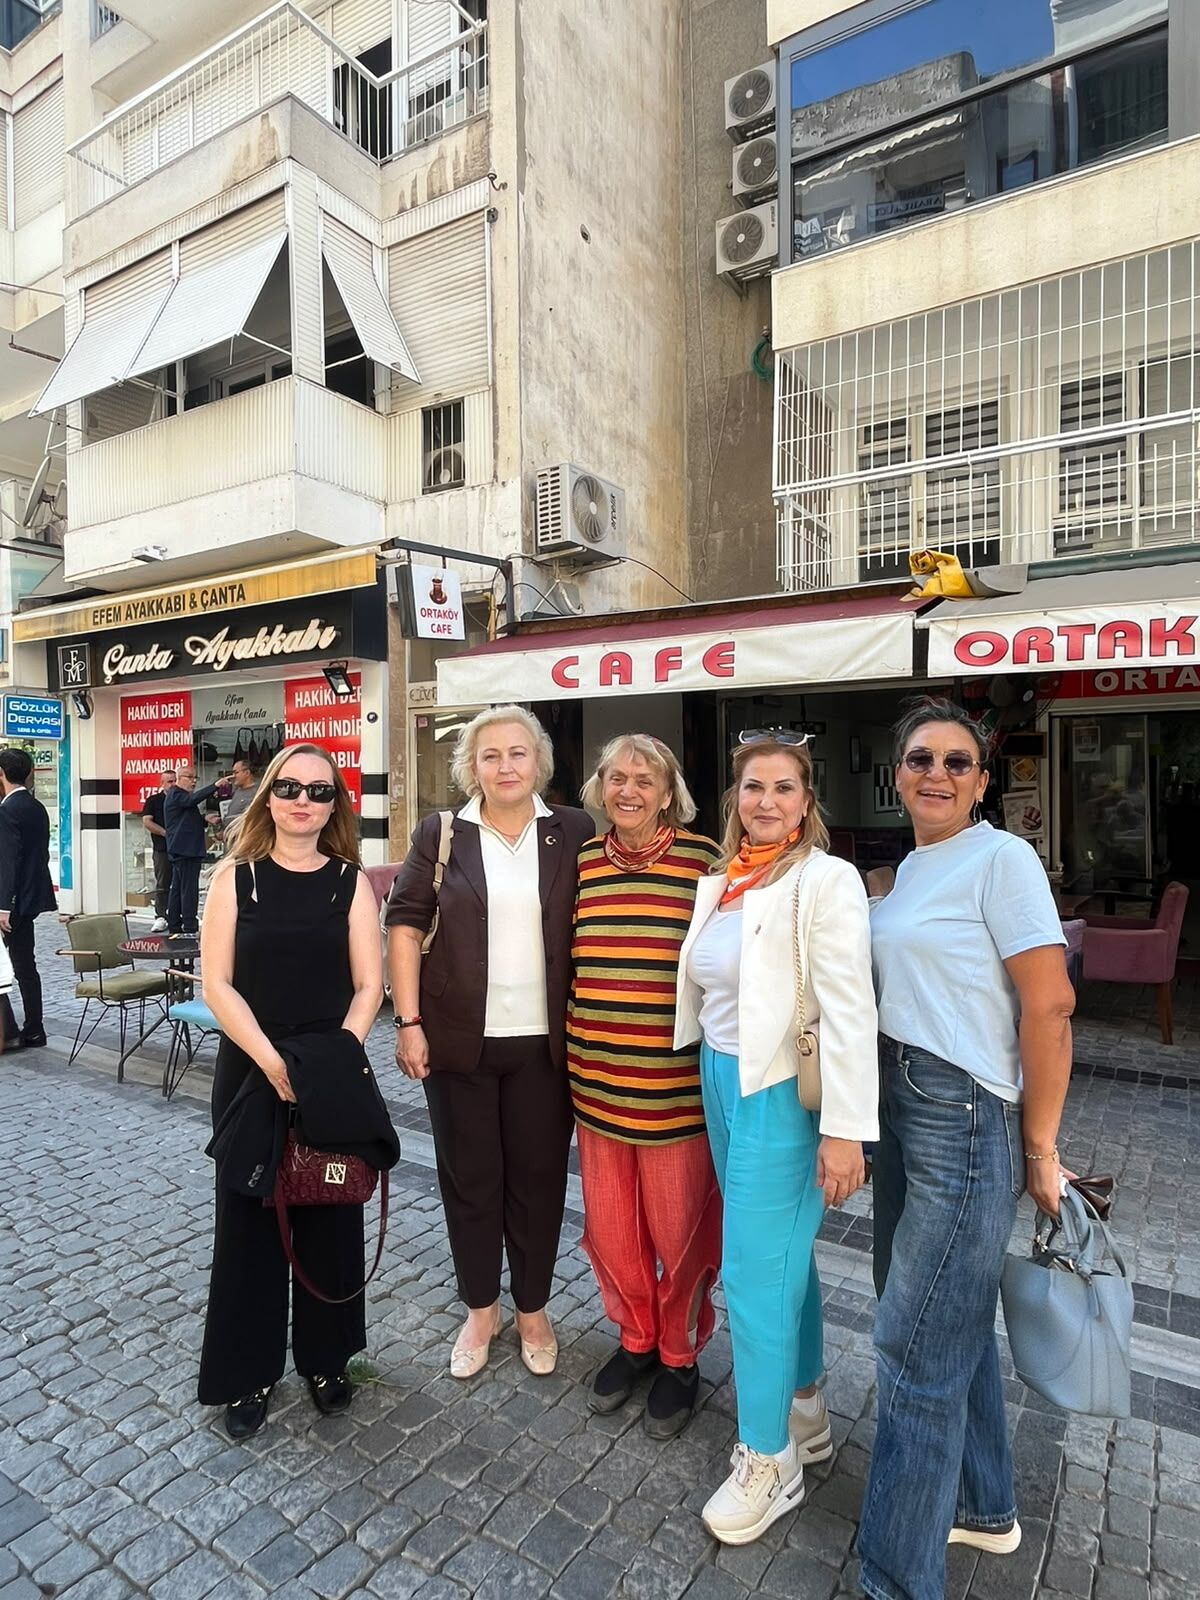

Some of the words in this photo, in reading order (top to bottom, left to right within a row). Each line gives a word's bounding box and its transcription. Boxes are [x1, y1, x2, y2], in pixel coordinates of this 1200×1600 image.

[92, 605, 122, 626] EFEM
[125, 594, 186, 621] AYAKKABI
[189, 592, 198, 610] &
[201, 583, 246, 612] ÇANTA
[420, 607, 459, 620] ORTAKÖY
[431, 623, 452, 635] CAFE
[102, 643, 174, 684] Çanta
[1094, 665, 1200, 692] ORTA
[9, 700, 59, 714] GÖZLÜK
[224, 693, 244, 706] Efem
[127, 701, 159, 721] HAKİKİ
[161, 698, 184, 719] DERİ
[243, 707, 267, 722] Çanta
[7, 712, 61, 726] DERYASI
[121, 729, 151, 748] HAKİKİ
[153, 726, 193, 747] İNDİRİM
[285, 717, 326, 740] HAKİKİ
